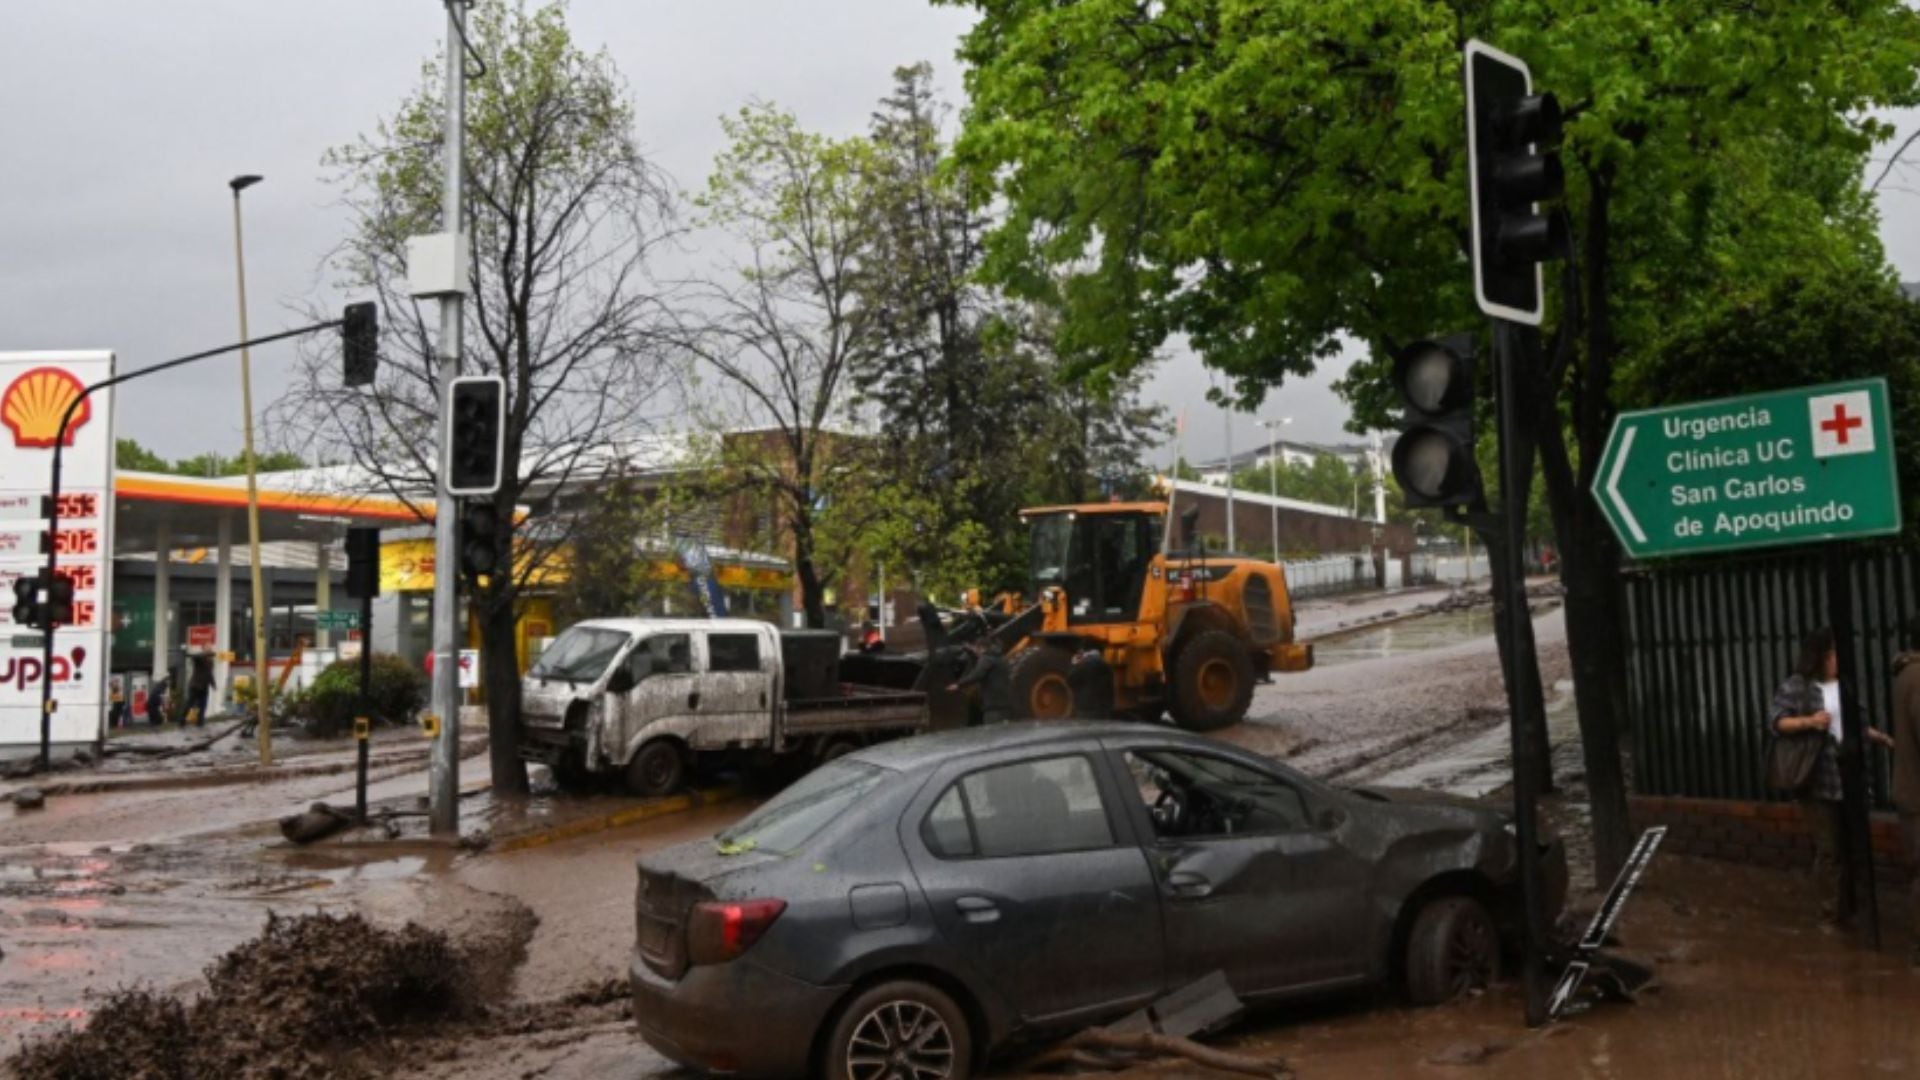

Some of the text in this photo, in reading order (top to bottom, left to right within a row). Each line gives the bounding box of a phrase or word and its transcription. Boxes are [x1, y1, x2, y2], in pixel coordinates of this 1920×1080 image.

[1663, 407, 1771, 440] Urgencia
[1756, 438, 1795, 463] UC
[1671, 475, 1805, 506] San Carlos
[1674, 500, 1854, 537] de Apoquindo
